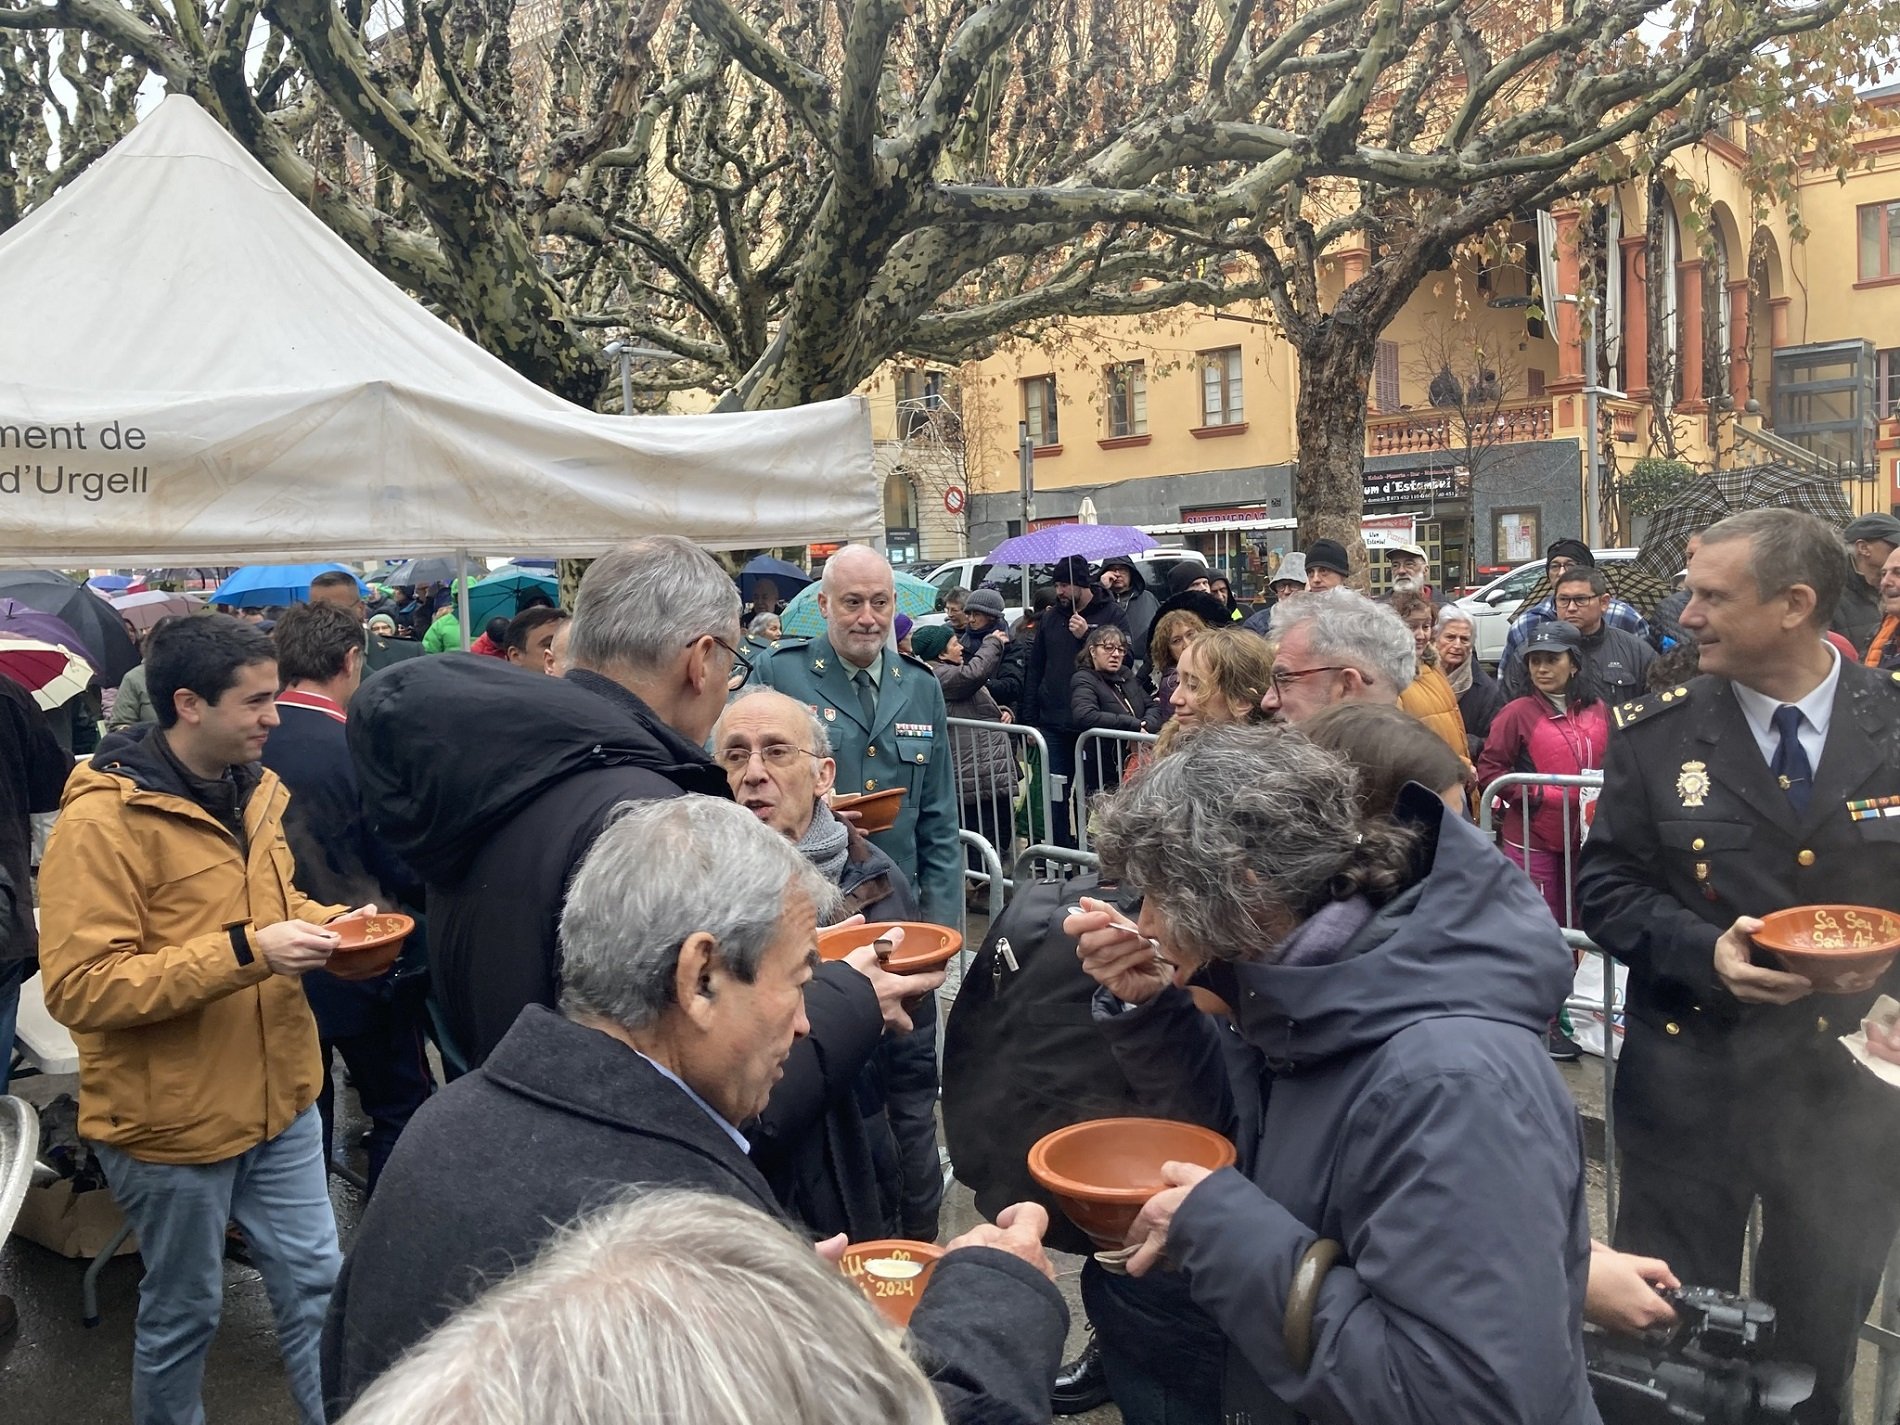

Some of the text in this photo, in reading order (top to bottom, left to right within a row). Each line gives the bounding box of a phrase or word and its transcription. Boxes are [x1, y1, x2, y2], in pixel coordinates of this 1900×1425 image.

[100, 420, 146, 450] de
[0, 465, 148, 502] d’Urgell
[875, 1280, 914, 1297] 2024
